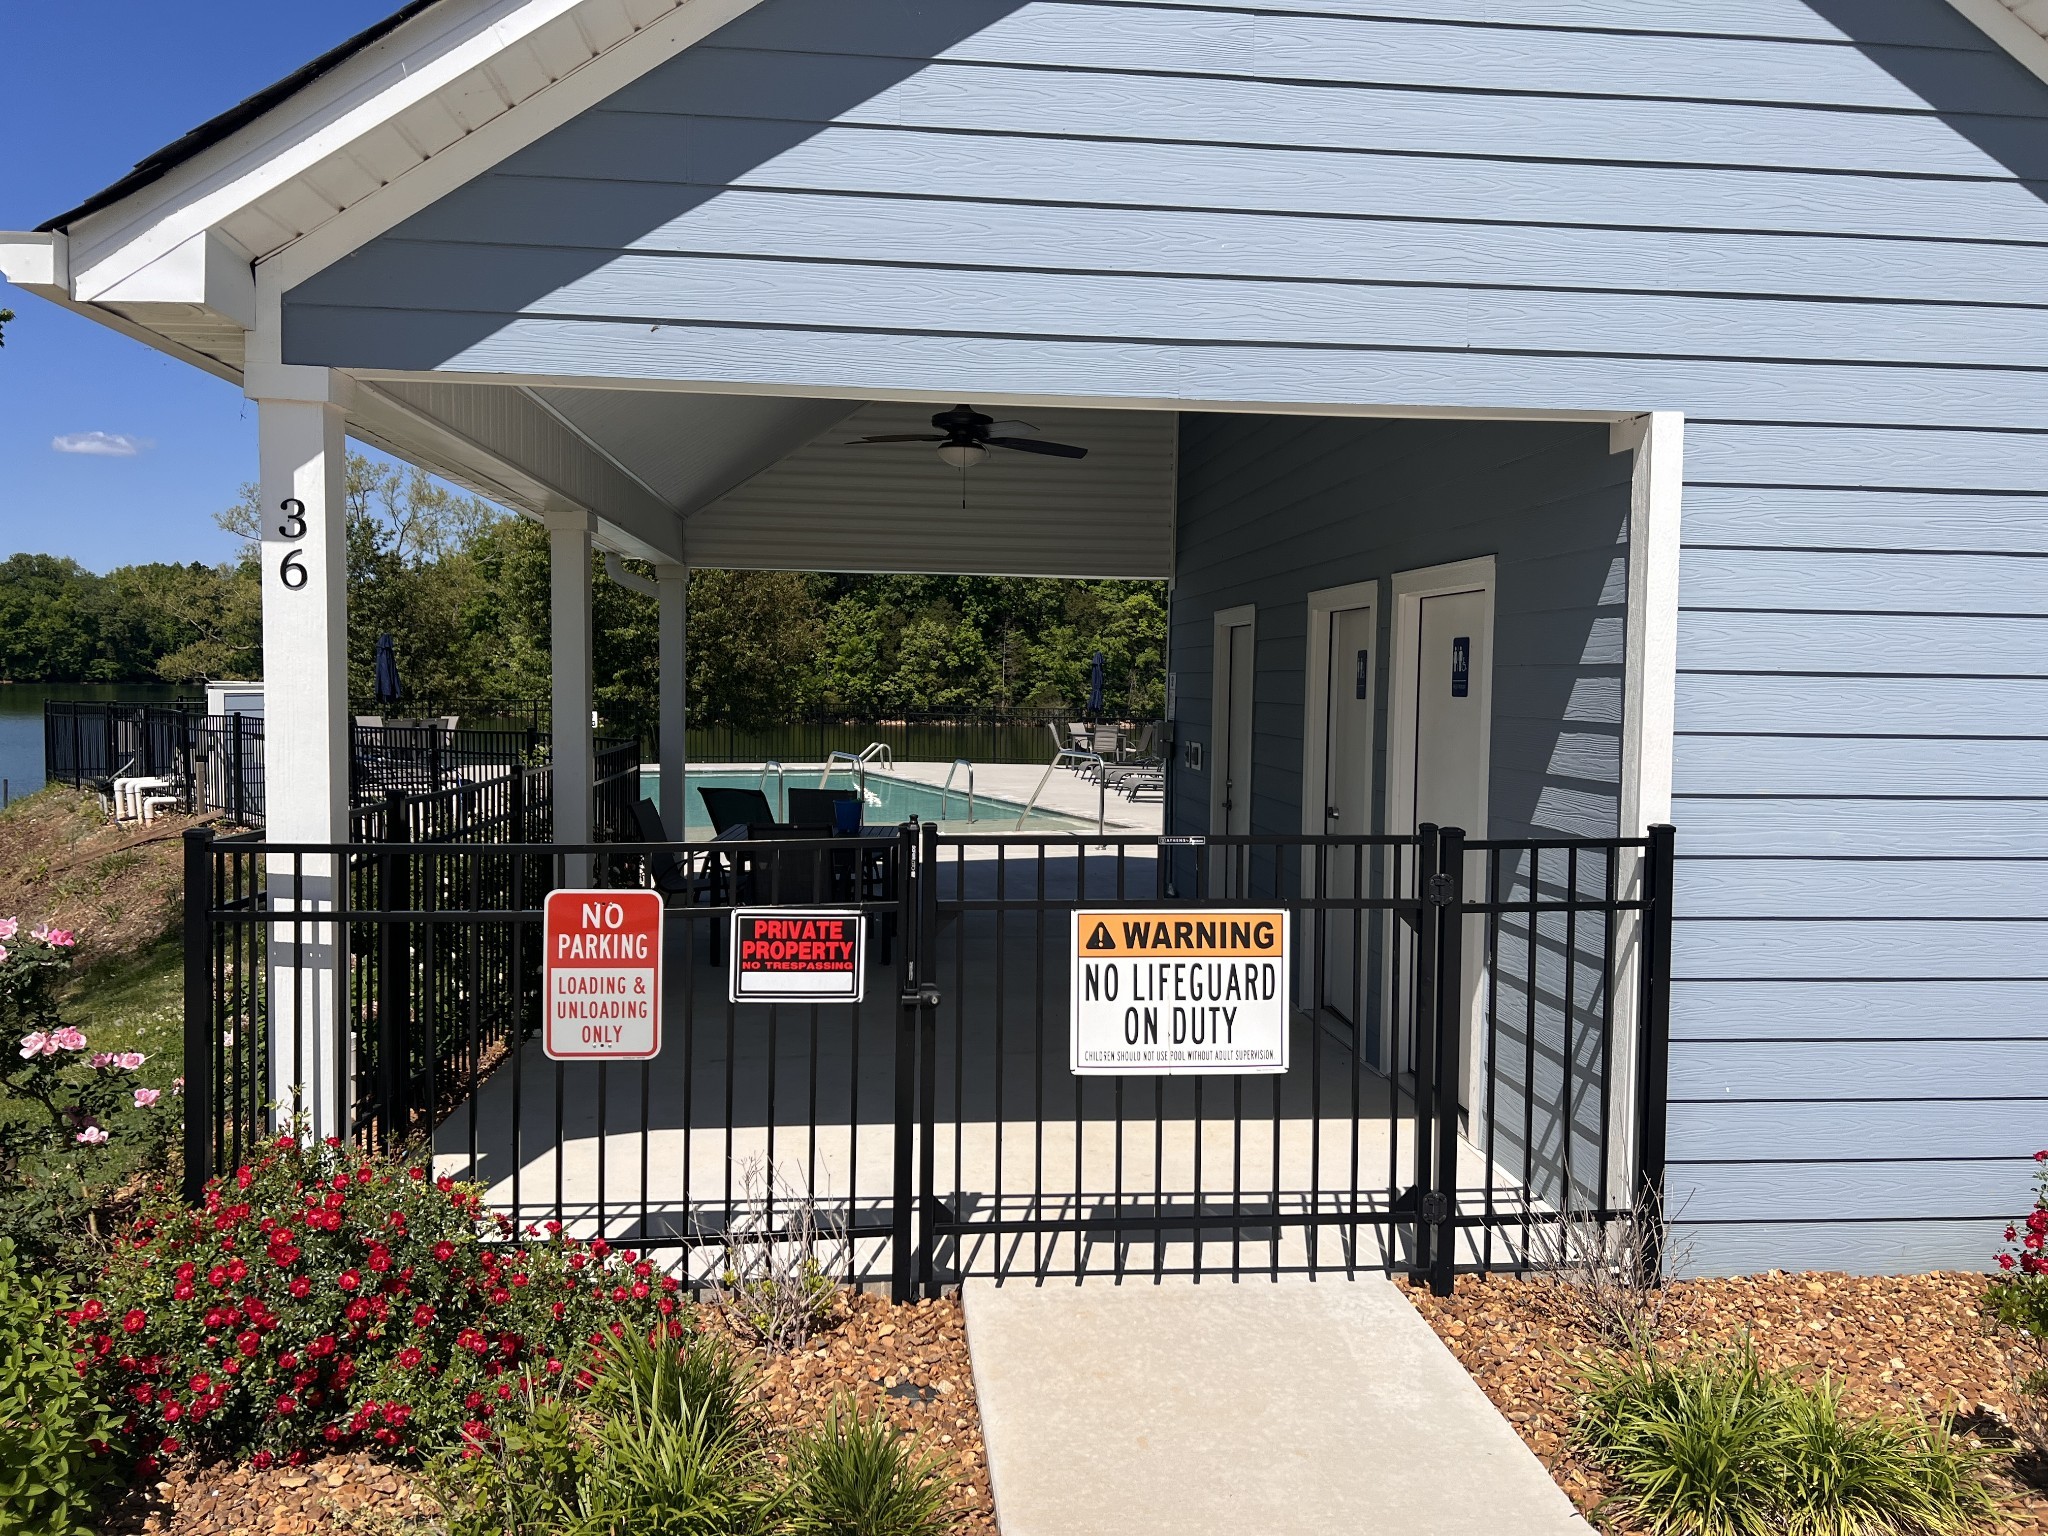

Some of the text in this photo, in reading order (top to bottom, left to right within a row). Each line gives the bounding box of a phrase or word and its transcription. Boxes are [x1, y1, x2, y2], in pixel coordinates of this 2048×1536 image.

[582, 903, 624, 929] NO
[754, 920, 843, 940] PRIVATE
[1122, 921, 1274, 949] WARNING
[558, 934, 648, 959] PARKING
[742, 940, 853, 960] PROPERTY
[742, 961, 853, 970] NO TRESPASSING
[558, 976, 646, 995] LOADING &
[1085, 963, 1275, 1001] NO LIFEGUARD
[557, 1001, 648, 1019] UNLOADING
[582, 1025, 623, 1043] ONLY
[1124, 1006, 1238, 1045] ON DUTY
[1084, 1050, 1115, 1062] CHILDREN
[1117, 1050, 1141, 1062] SHOULD
[1143, 1050, 1154, 1062] NOT
[1156, 1050, 1168, 1062] USE
[1170, 1050, 1186, 1062] POOL
[1187, 1050, 1213, 1061] WITHOUT
[1214, 1050, 1233, 1061] ADULT
